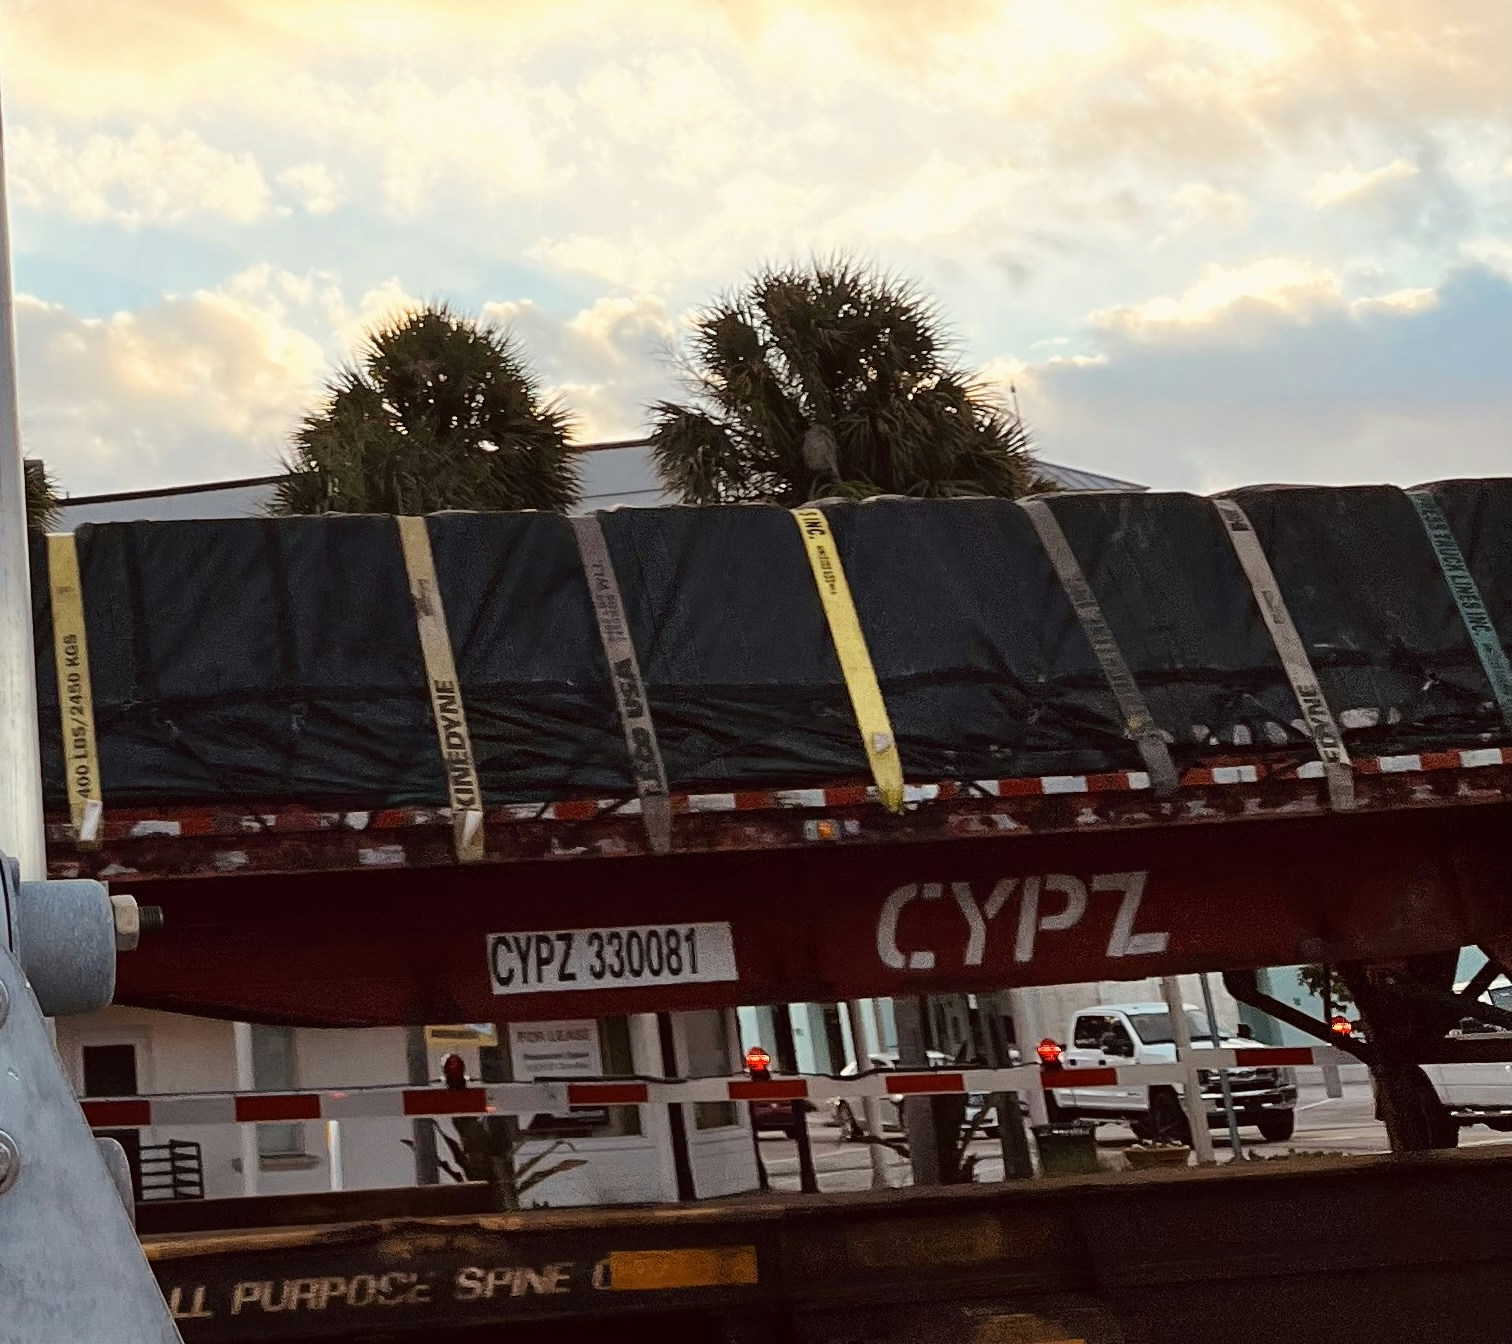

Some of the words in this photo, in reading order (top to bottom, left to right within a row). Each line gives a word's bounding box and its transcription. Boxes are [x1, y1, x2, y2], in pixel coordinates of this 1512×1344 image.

[434, 680, 482, 812] KINEDYNE
[491, 932, 577, 987] CYPZ
[588, 927, 699, 980] 330081
[876, 871, 1170, 969] CYPZ
[231, 1270, 432, 1315] PURPOSE
[455, 1261, 574, 1300] SPINE
